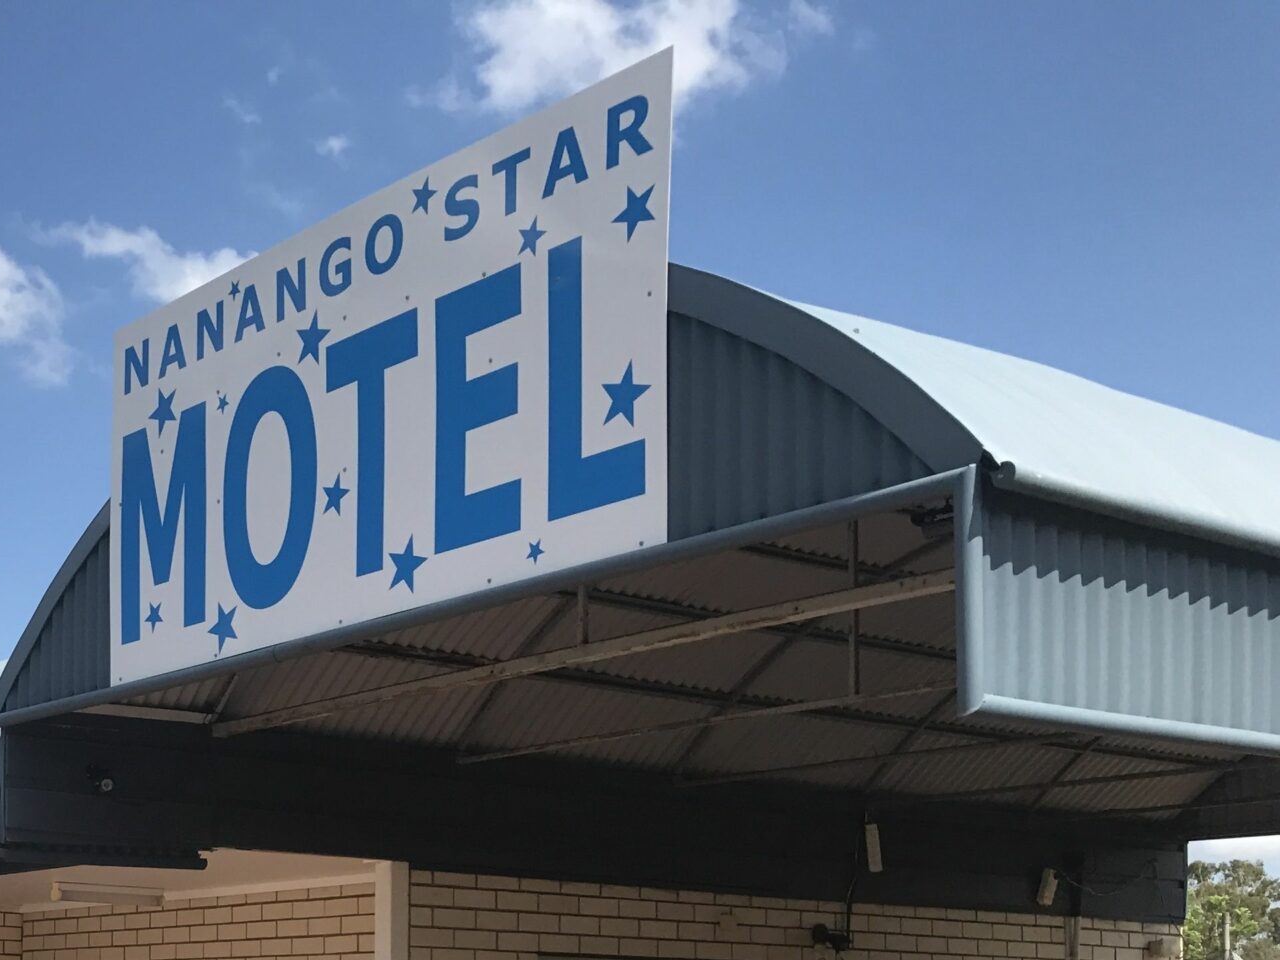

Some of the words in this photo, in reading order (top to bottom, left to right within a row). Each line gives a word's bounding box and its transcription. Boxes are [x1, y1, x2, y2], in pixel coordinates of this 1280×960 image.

[124, 213, 404, 396] NANANGO
[443, 94, 654, 242] STAR
[121, 235, 647, 647] MOTEL
